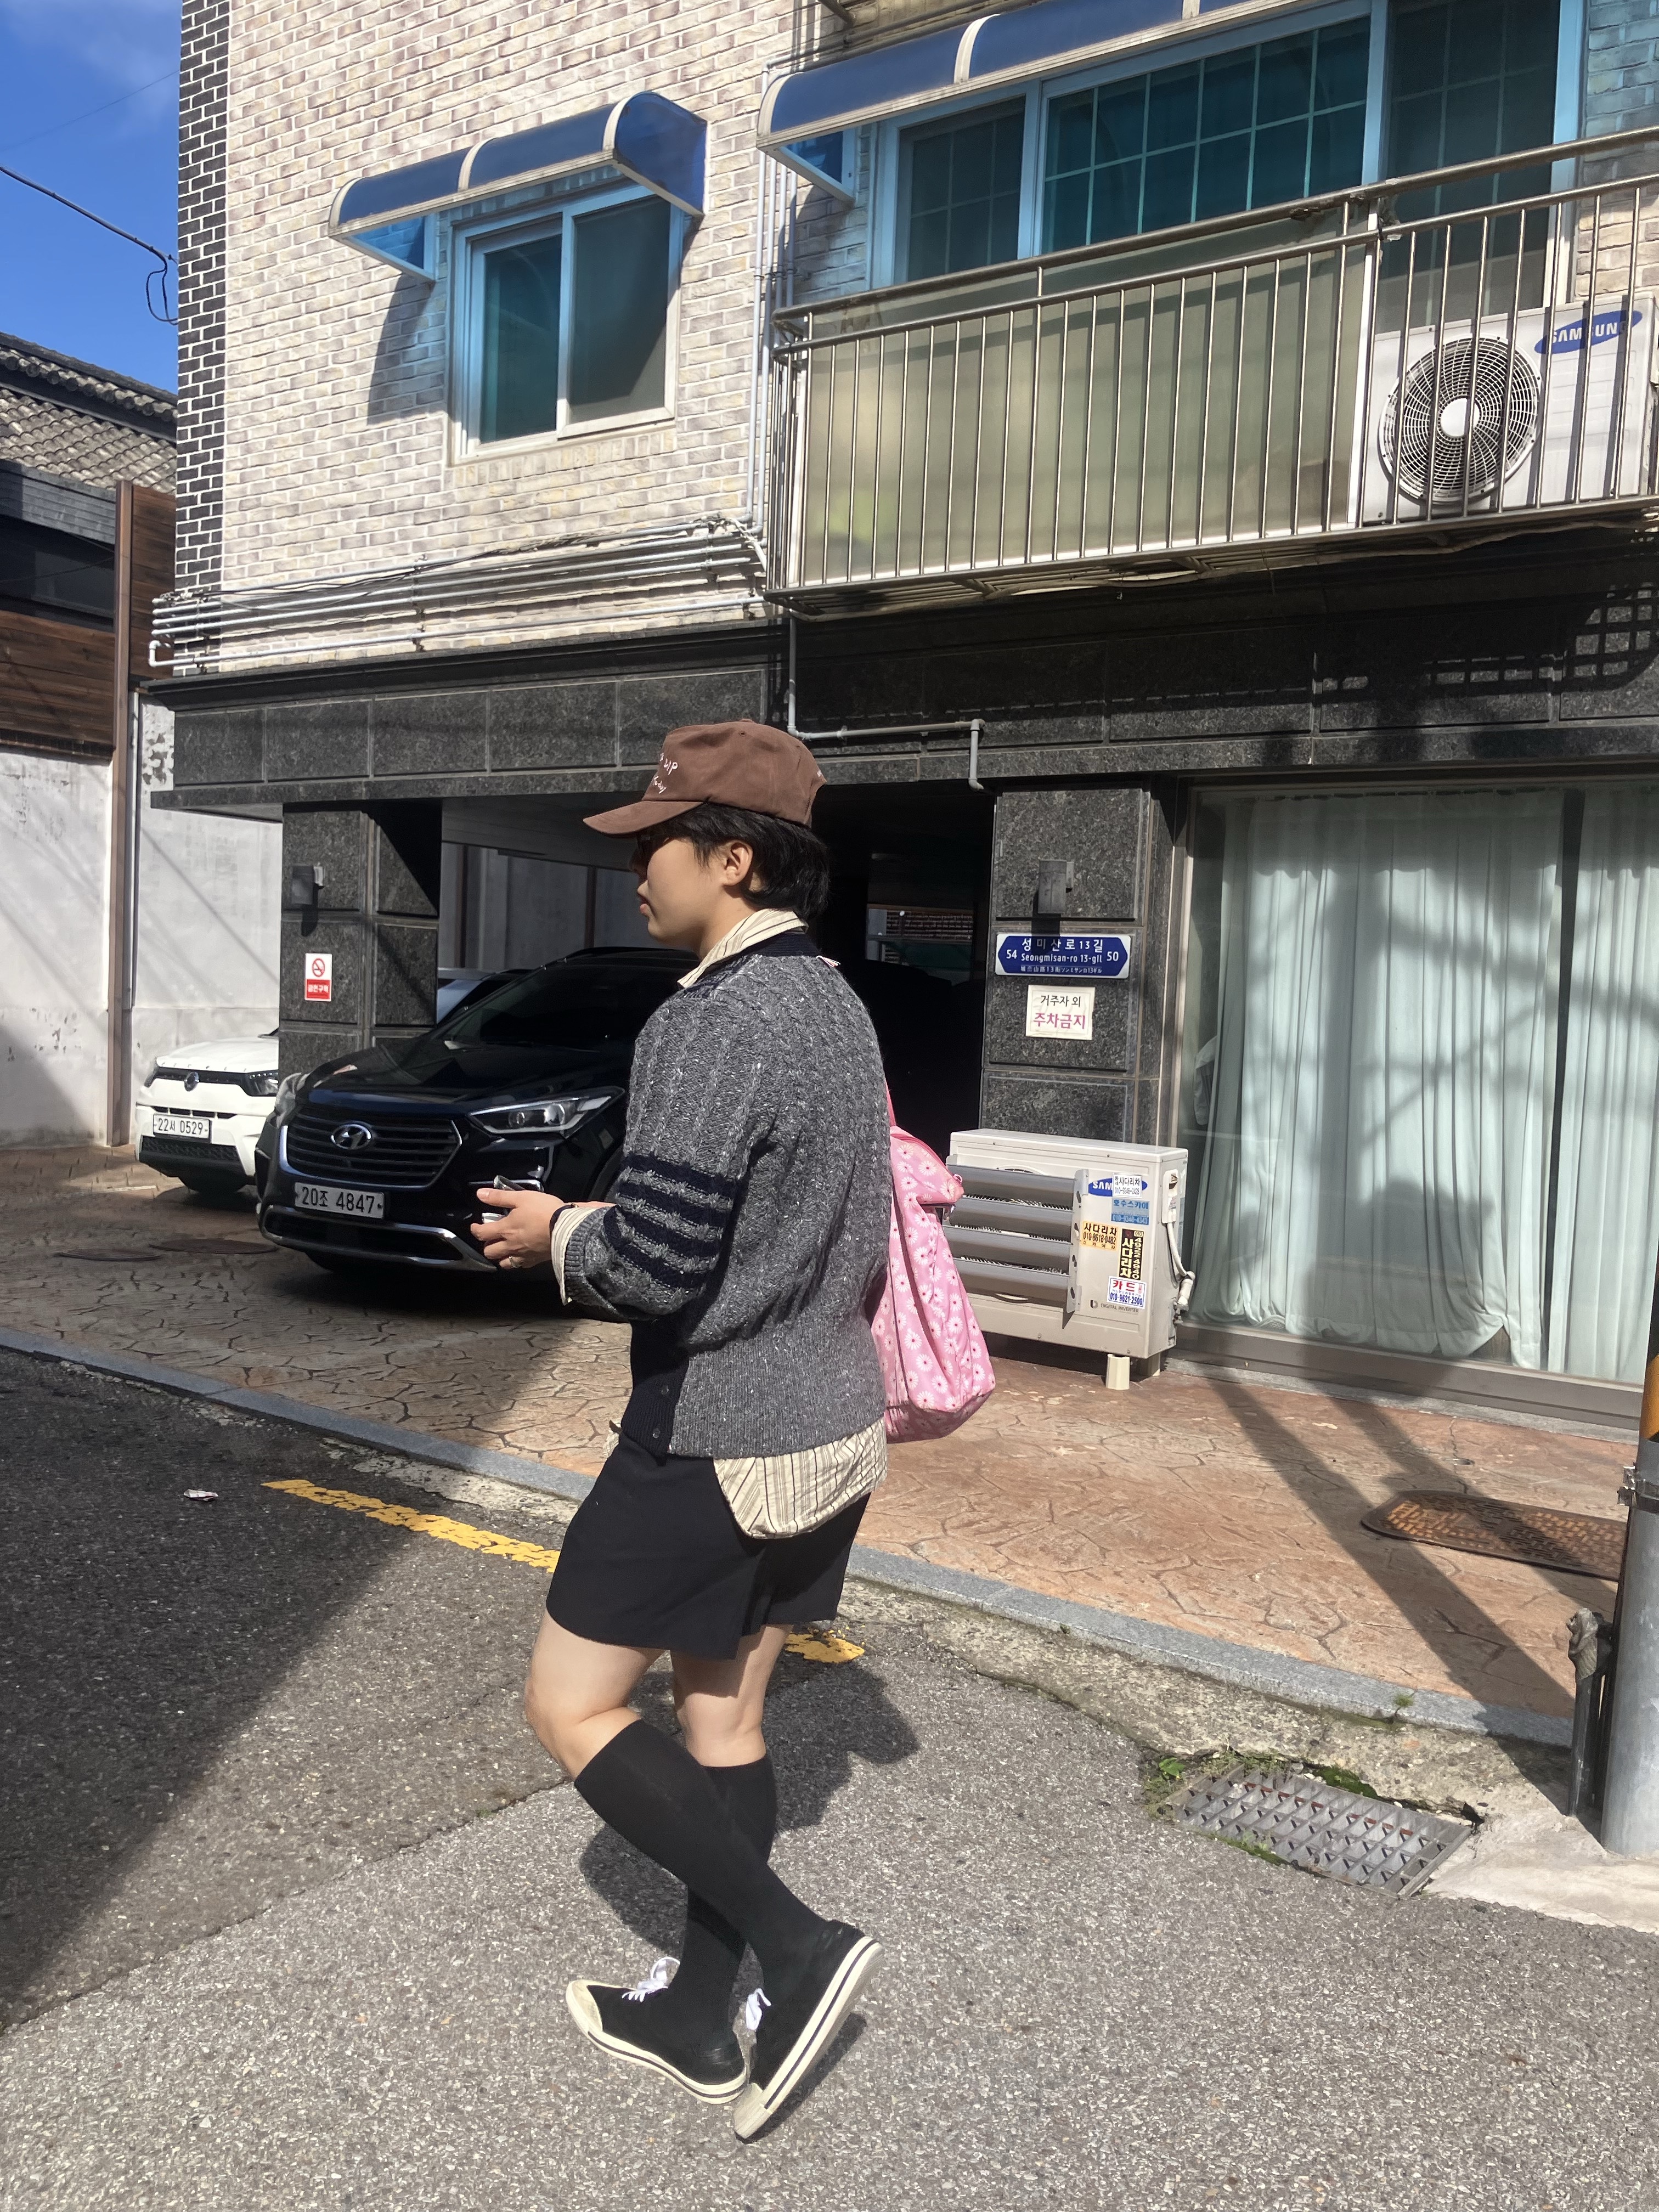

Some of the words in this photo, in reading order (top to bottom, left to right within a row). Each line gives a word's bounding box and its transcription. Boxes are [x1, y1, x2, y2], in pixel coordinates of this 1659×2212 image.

[1006, 949, 1018, 960] 54
[1021, 953, 1077, 963] Seongmisan-ro
[1080, 955, 1102, 964] 13-gil
[1107, 951, 1119, 962] 50
[1040, 995, 1069, 1007] 거주자
[1071, 996, 1081, 1008] 외
[1033, 1013, 1086, 1030] 주차금지
[180, 1120, 203, 1135] 0529
[1119, 1176, 1141, 1187] 사다리차
[302, 1186, 328, 1206] 20조
[336, 1192, 375, 1214] 4847
[1112, 1279, 1136, 1292] 카드
